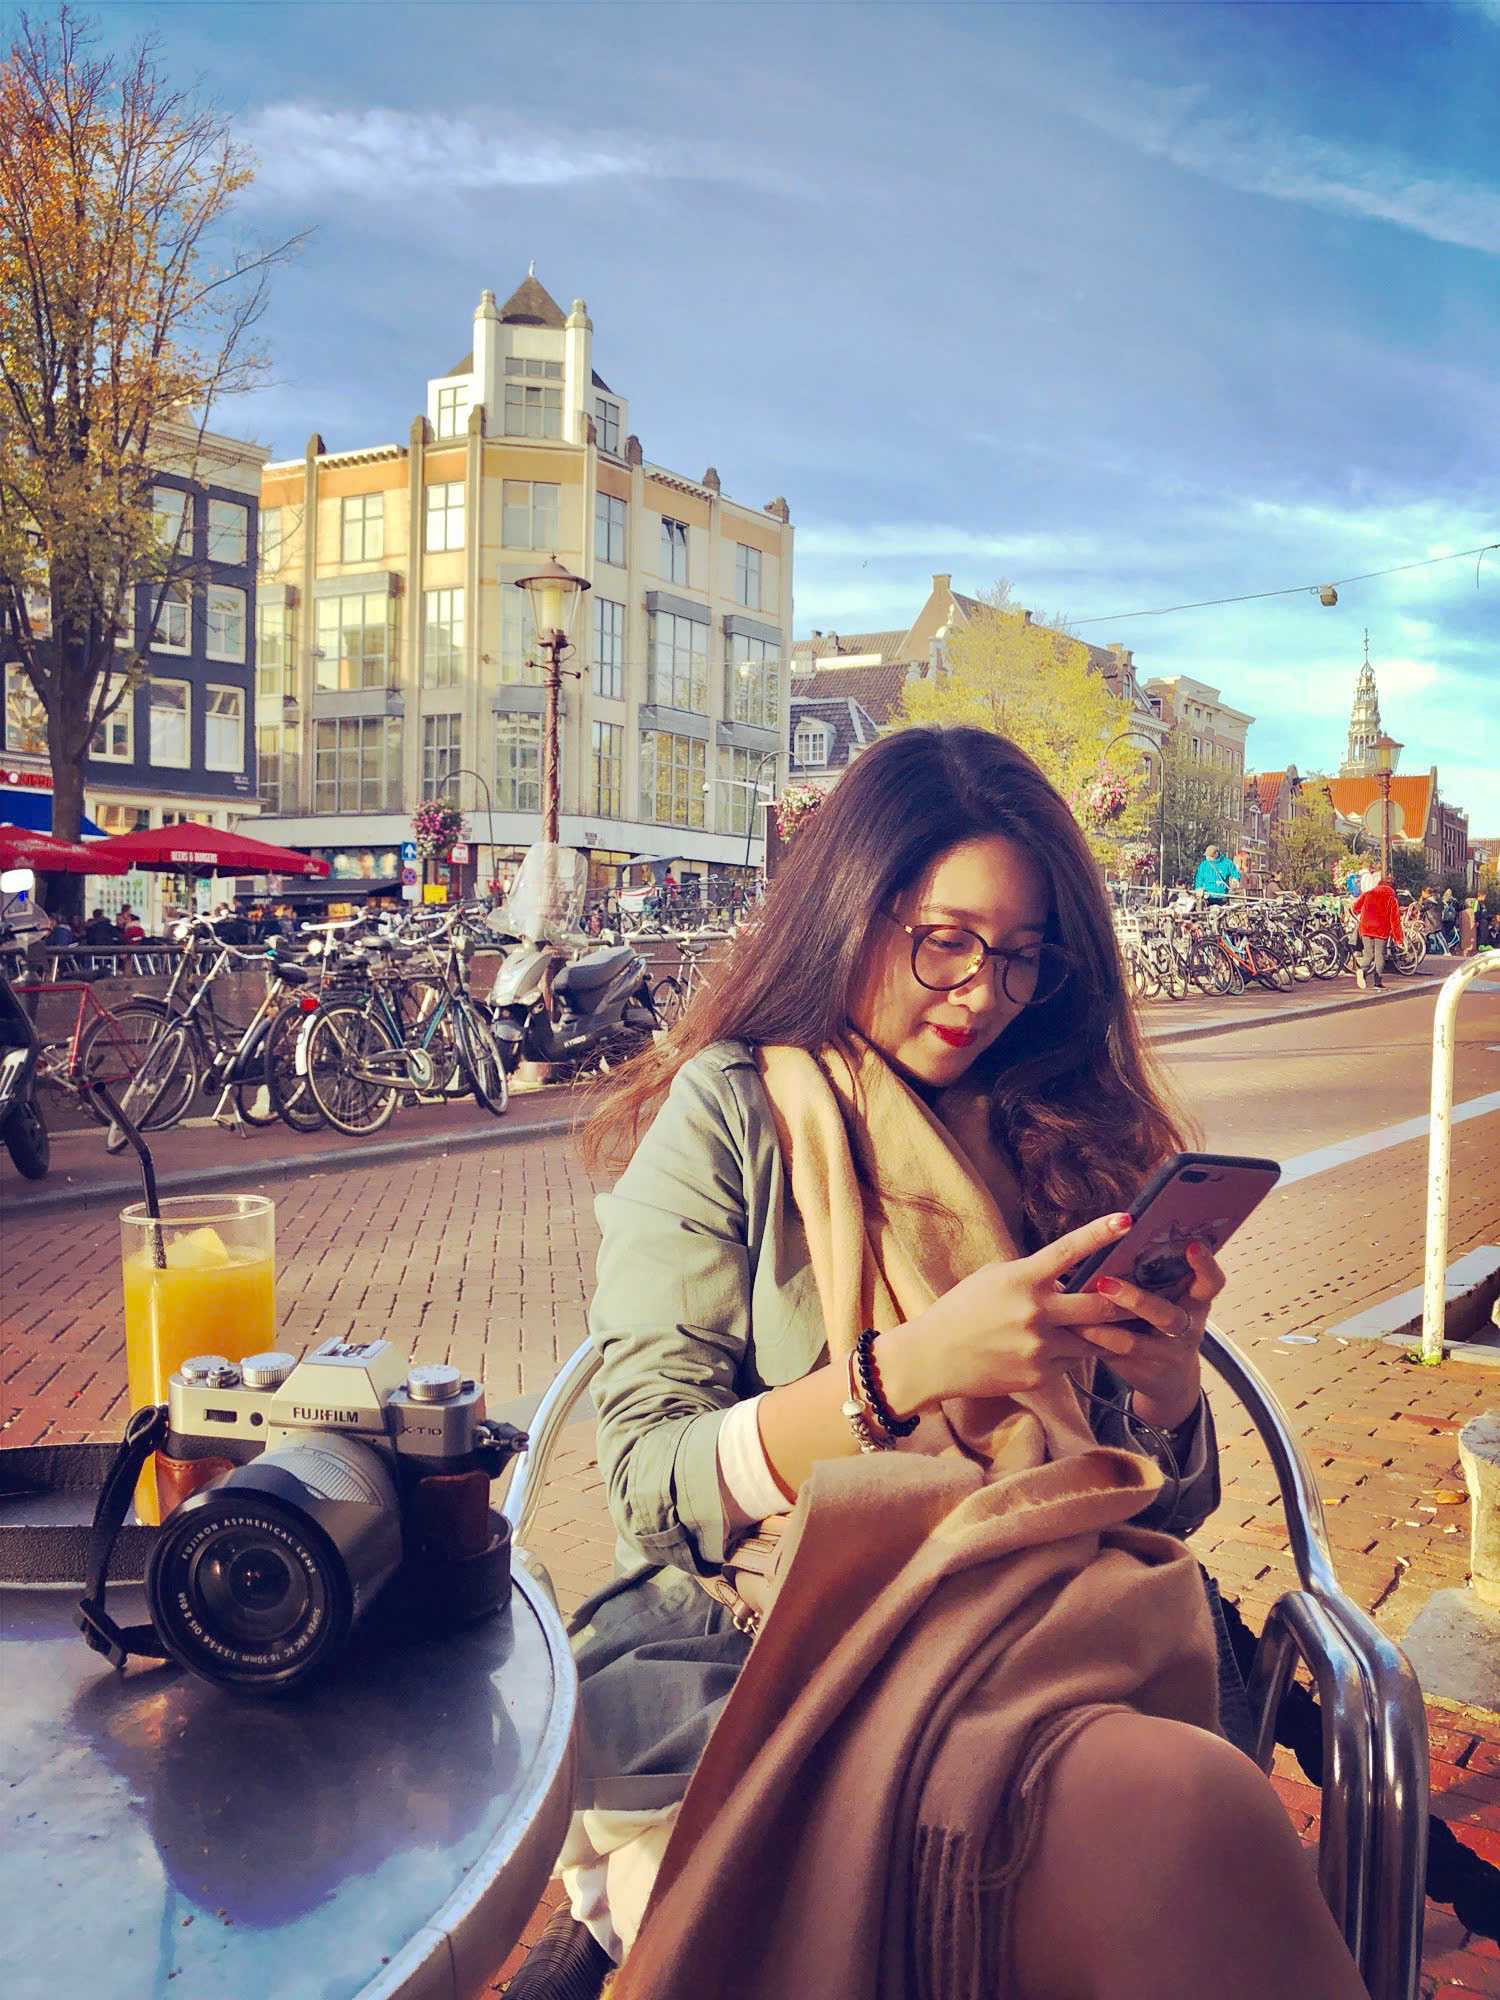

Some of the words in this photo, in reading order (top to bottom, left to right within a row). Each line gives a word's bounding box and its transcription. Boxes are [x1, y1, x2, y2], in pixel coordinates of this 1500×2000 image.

[293, 1407, 359, 1423] FUJIFILM
[401, 1425, 442, 1436] X-T10
[181, 1523, 219, 1560] FUJINON
[224, 1518, 293, 1545] ASPHERICAL
[295, 1546, 316, 1574] LENS
[241, 1652, 281, 1665] 16-50mm
